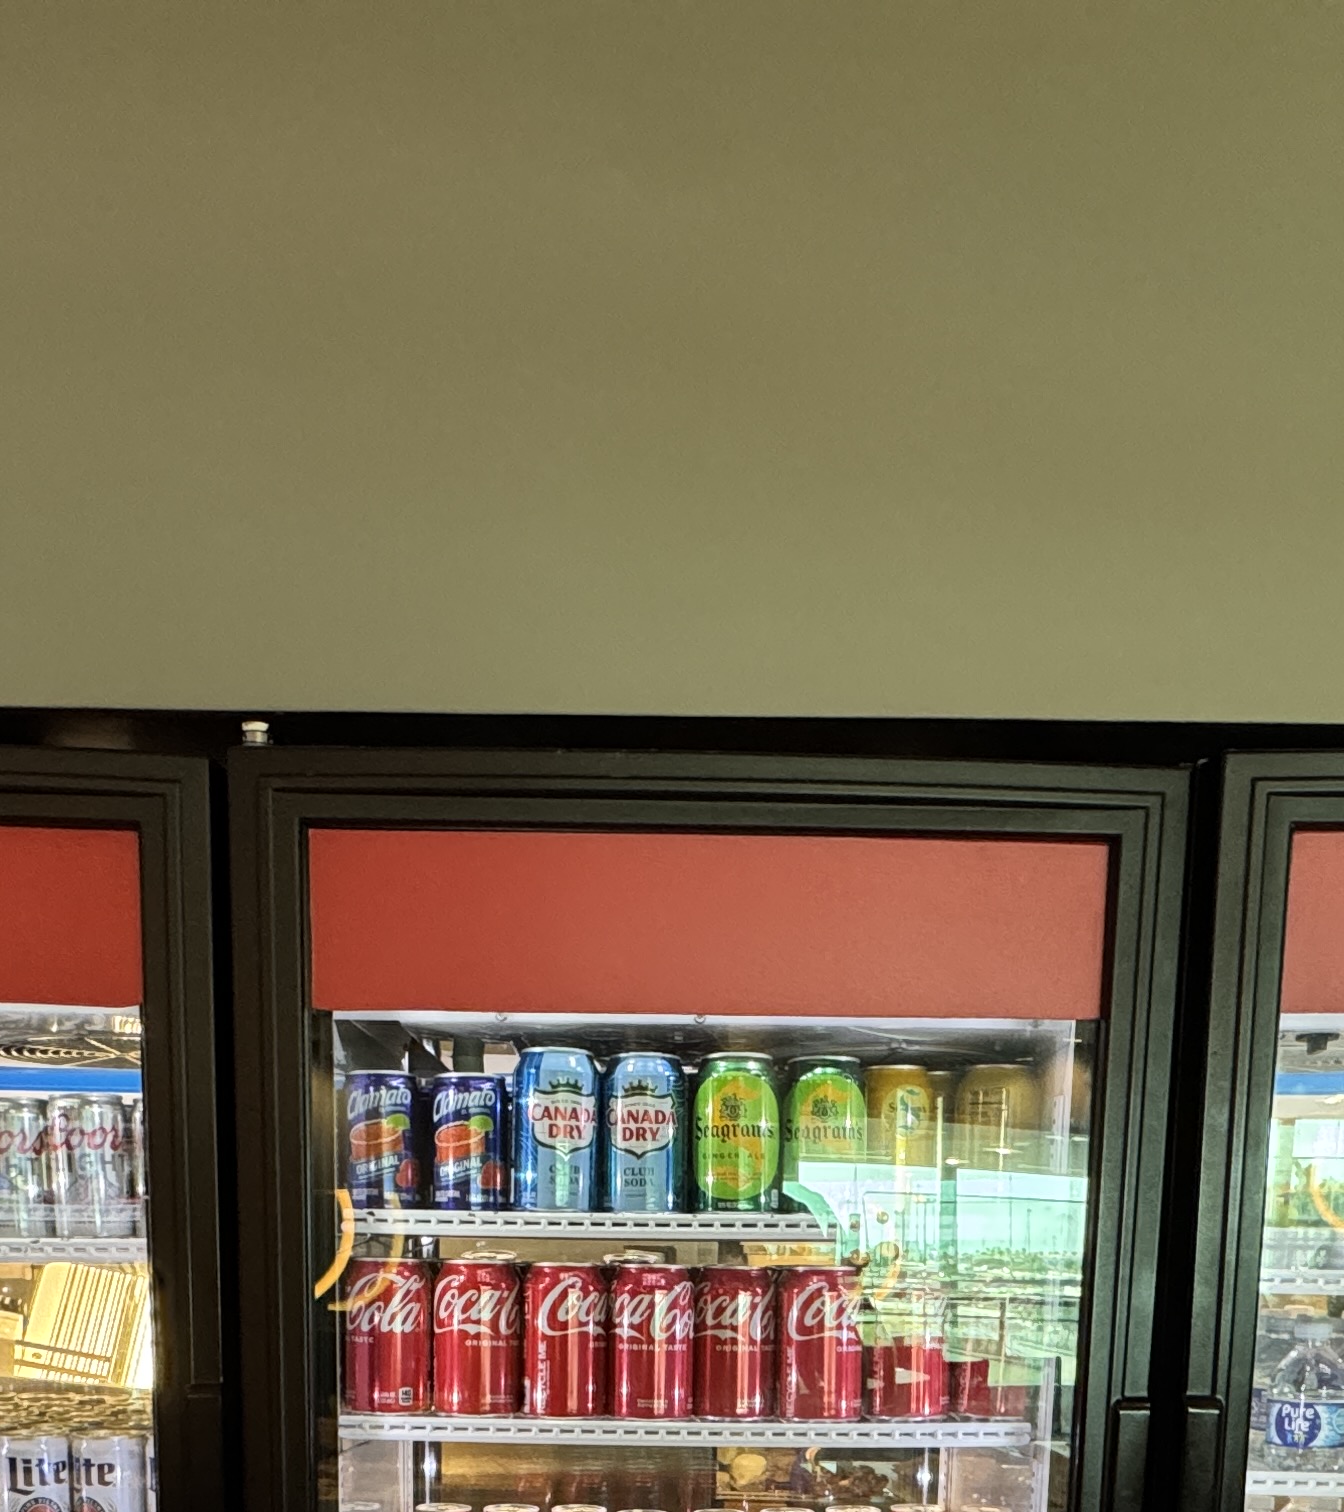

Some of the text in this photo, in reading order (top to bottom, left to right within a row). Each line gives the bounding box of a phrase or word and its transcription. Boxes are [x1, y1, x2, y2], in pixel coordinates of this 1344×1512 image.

[346, 1085, 412, 1121] Clamato
[433, 1086, 496, 1123] Clamato
[530, 1104, 598, 1127] CANADA
[607, 1108, 677, 1127] CANADA
[548, 1123, 587, 1140] DRY
[622, 1126, 661, 1142] DRY
[624, 1166, 655, 1177] CLUB
[8, 1456, 68, 1495] Lite
